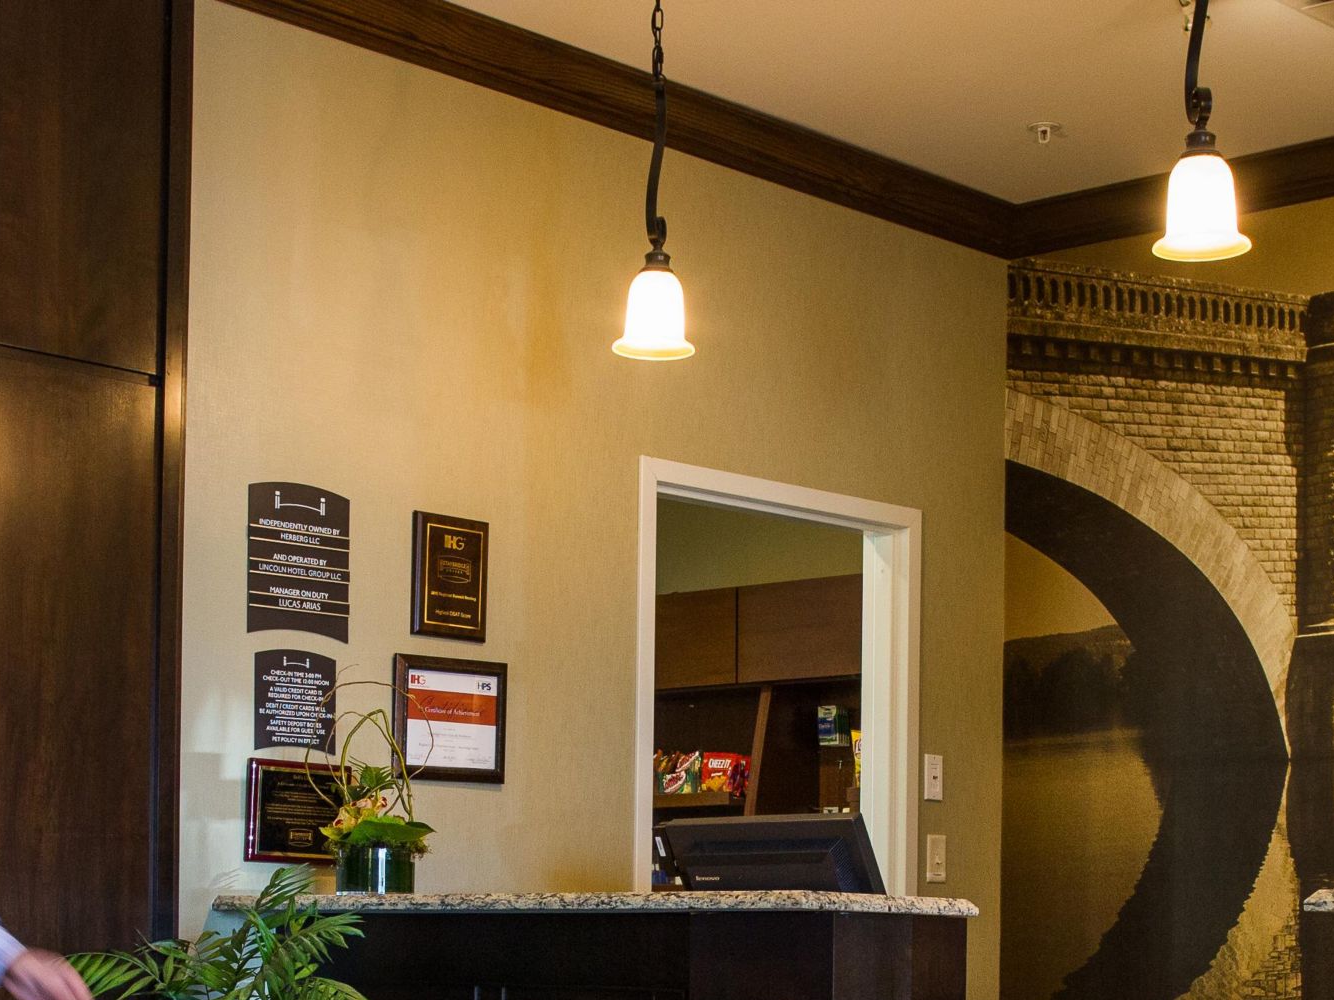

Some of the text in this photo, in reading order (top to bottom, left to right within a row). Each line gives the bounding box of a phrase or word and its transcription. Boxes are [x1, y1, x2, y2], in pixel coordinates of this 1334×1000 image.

[259, 518, 307, 530] INDEPENDENTLY
[309, 525, 332, 534] OWNED
[281, 533, 308, 542] HERBERG
[444, 534, 465, 551] IHG
[273, 553, 287, 561] AND
[288, 555, 318, 565] OPERATED
[259, 563, 287, 573] LINCOLN
[288, 567, 307, 575] HOTEL
[308, 569, 330, 578] GROUP
[270, 586, 300, 596] MANAGER
[312, 591, 328, 599] DUTY
[279, 598, 321, 611] LUCAS ARIAS
[411, 674, 426, 685] IHG
